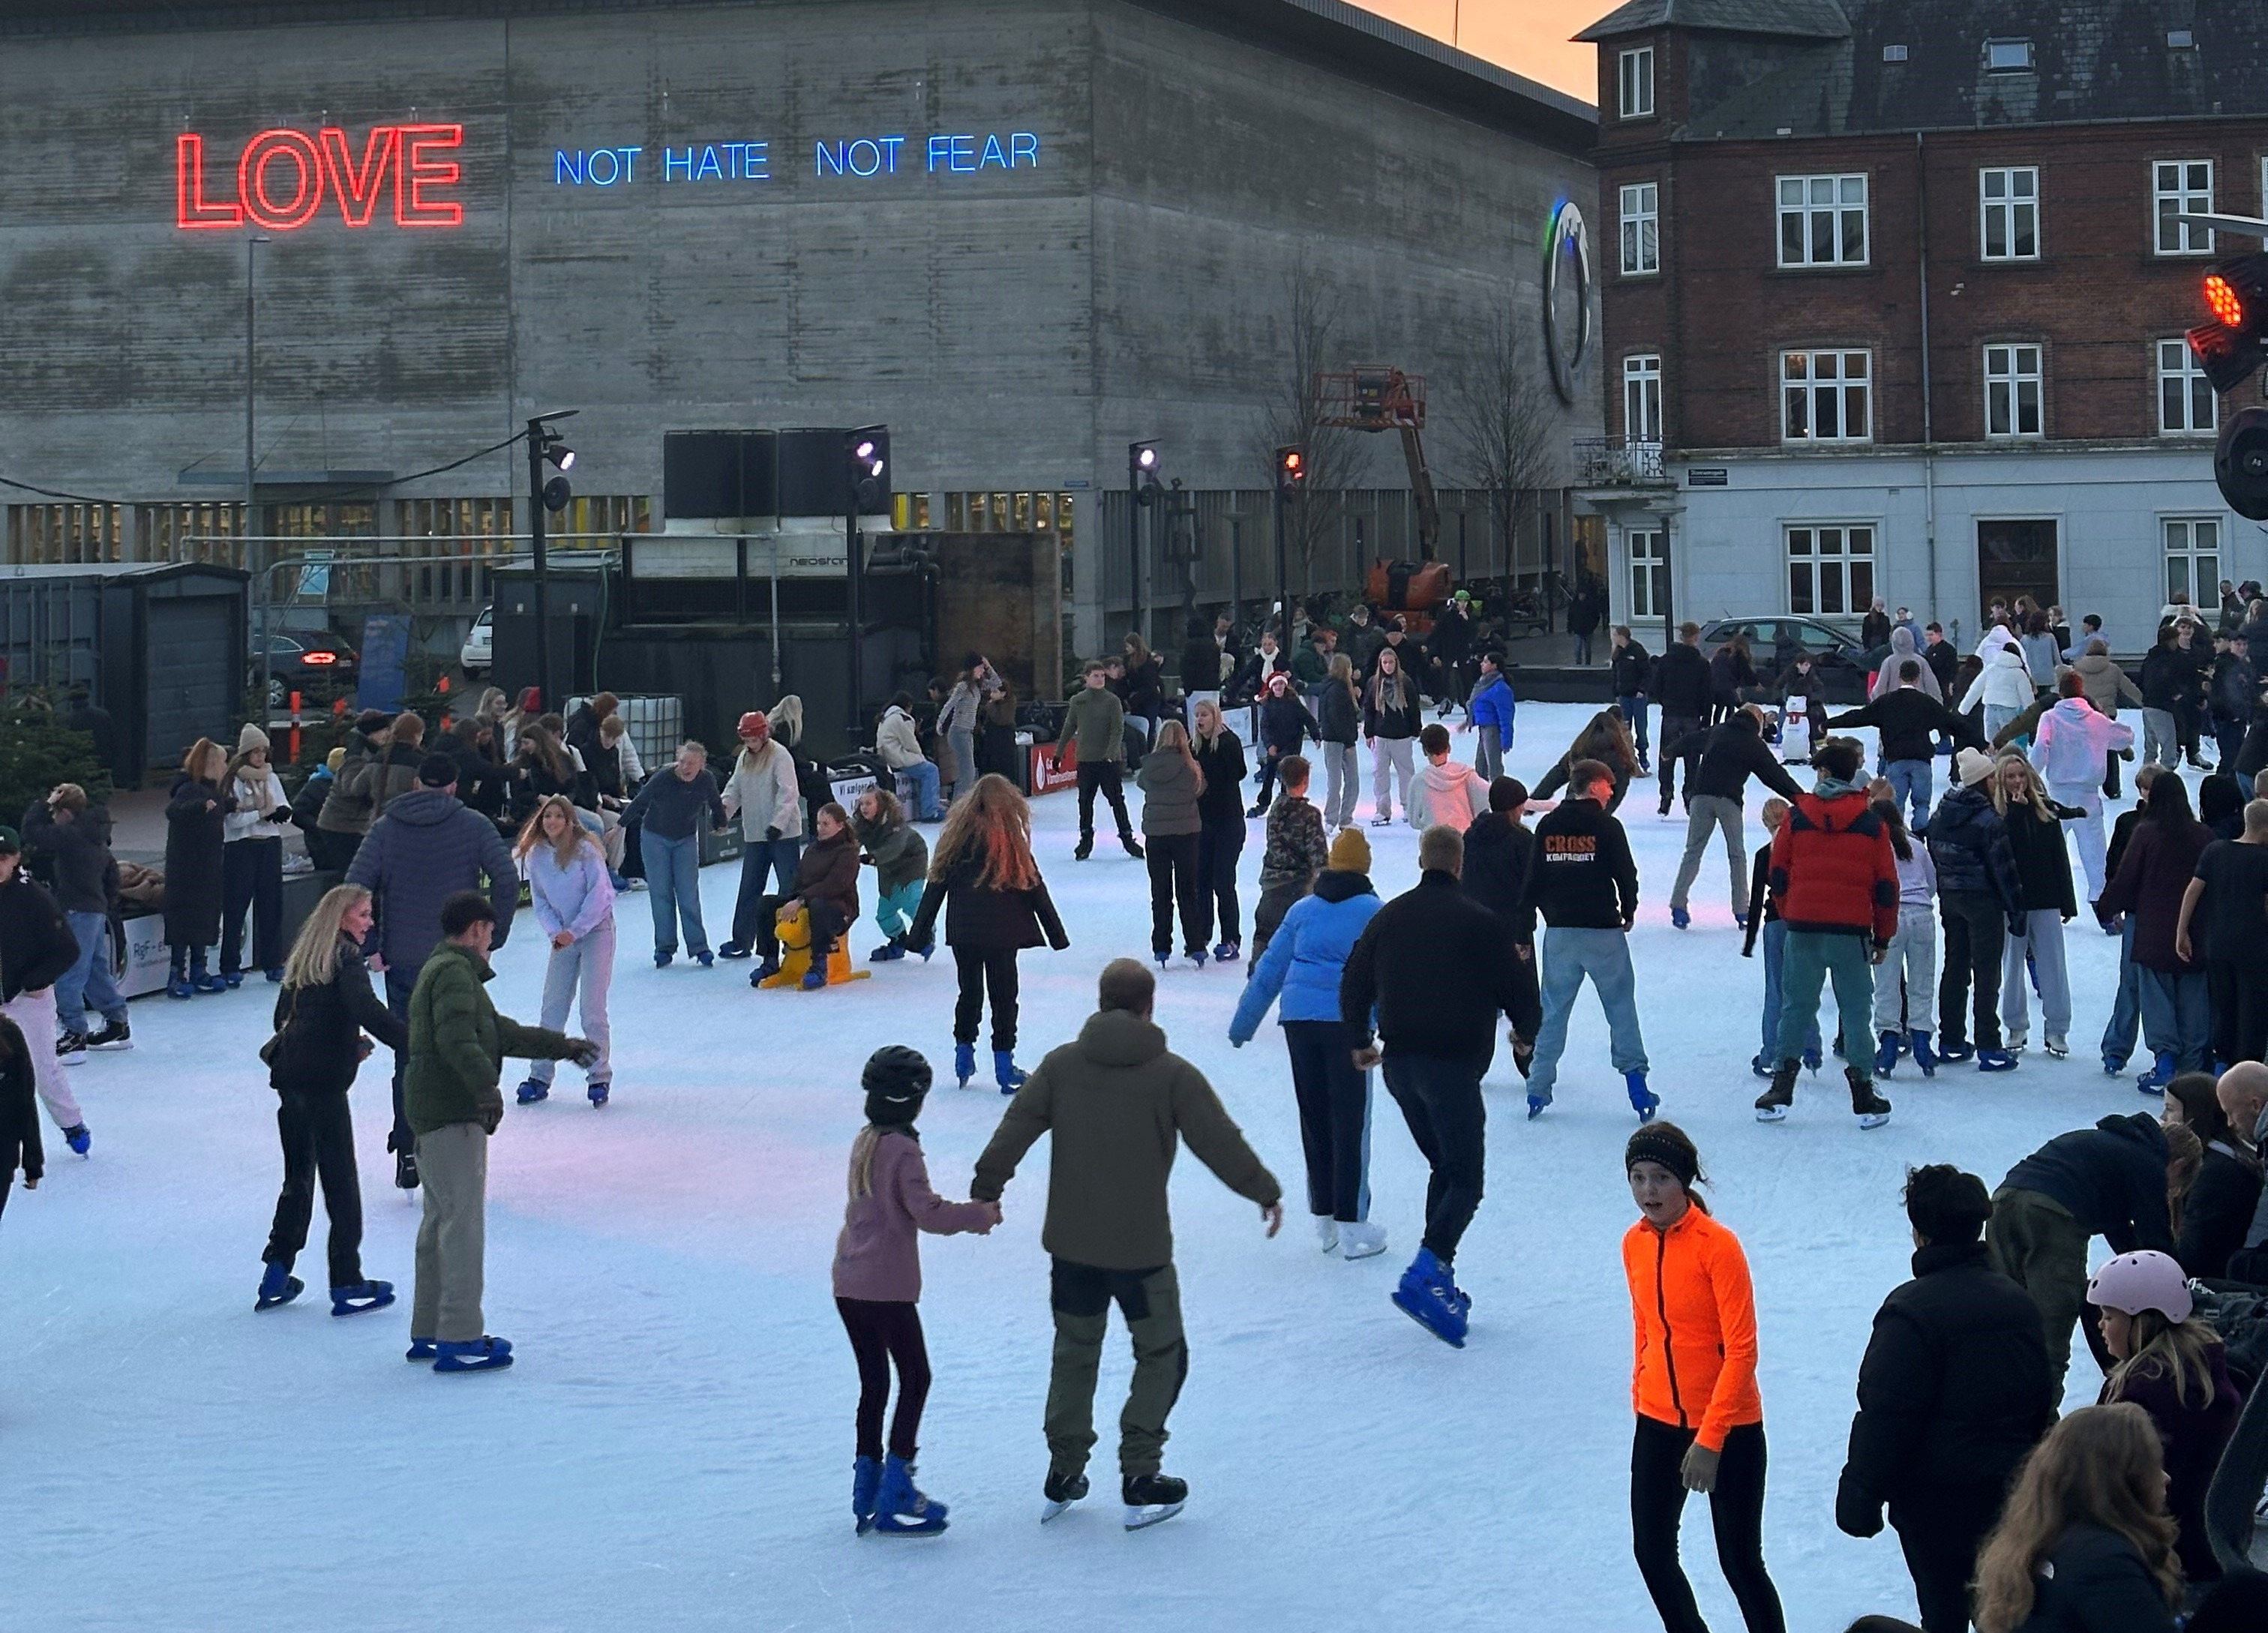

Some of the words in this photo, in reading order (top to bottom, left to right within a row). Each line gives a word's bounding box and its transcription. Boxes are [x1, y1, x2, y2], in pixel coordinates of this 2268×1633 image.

[177, 124, 463, 230] LOVE
[556, 147, 643, 186] NOT
[665, 142, 770, 182] HATE
[817, 137, 904, 176] NOT
[928, 132, 1039, 173] FEAR
[1545, 835, 1596, 852] CROSS
